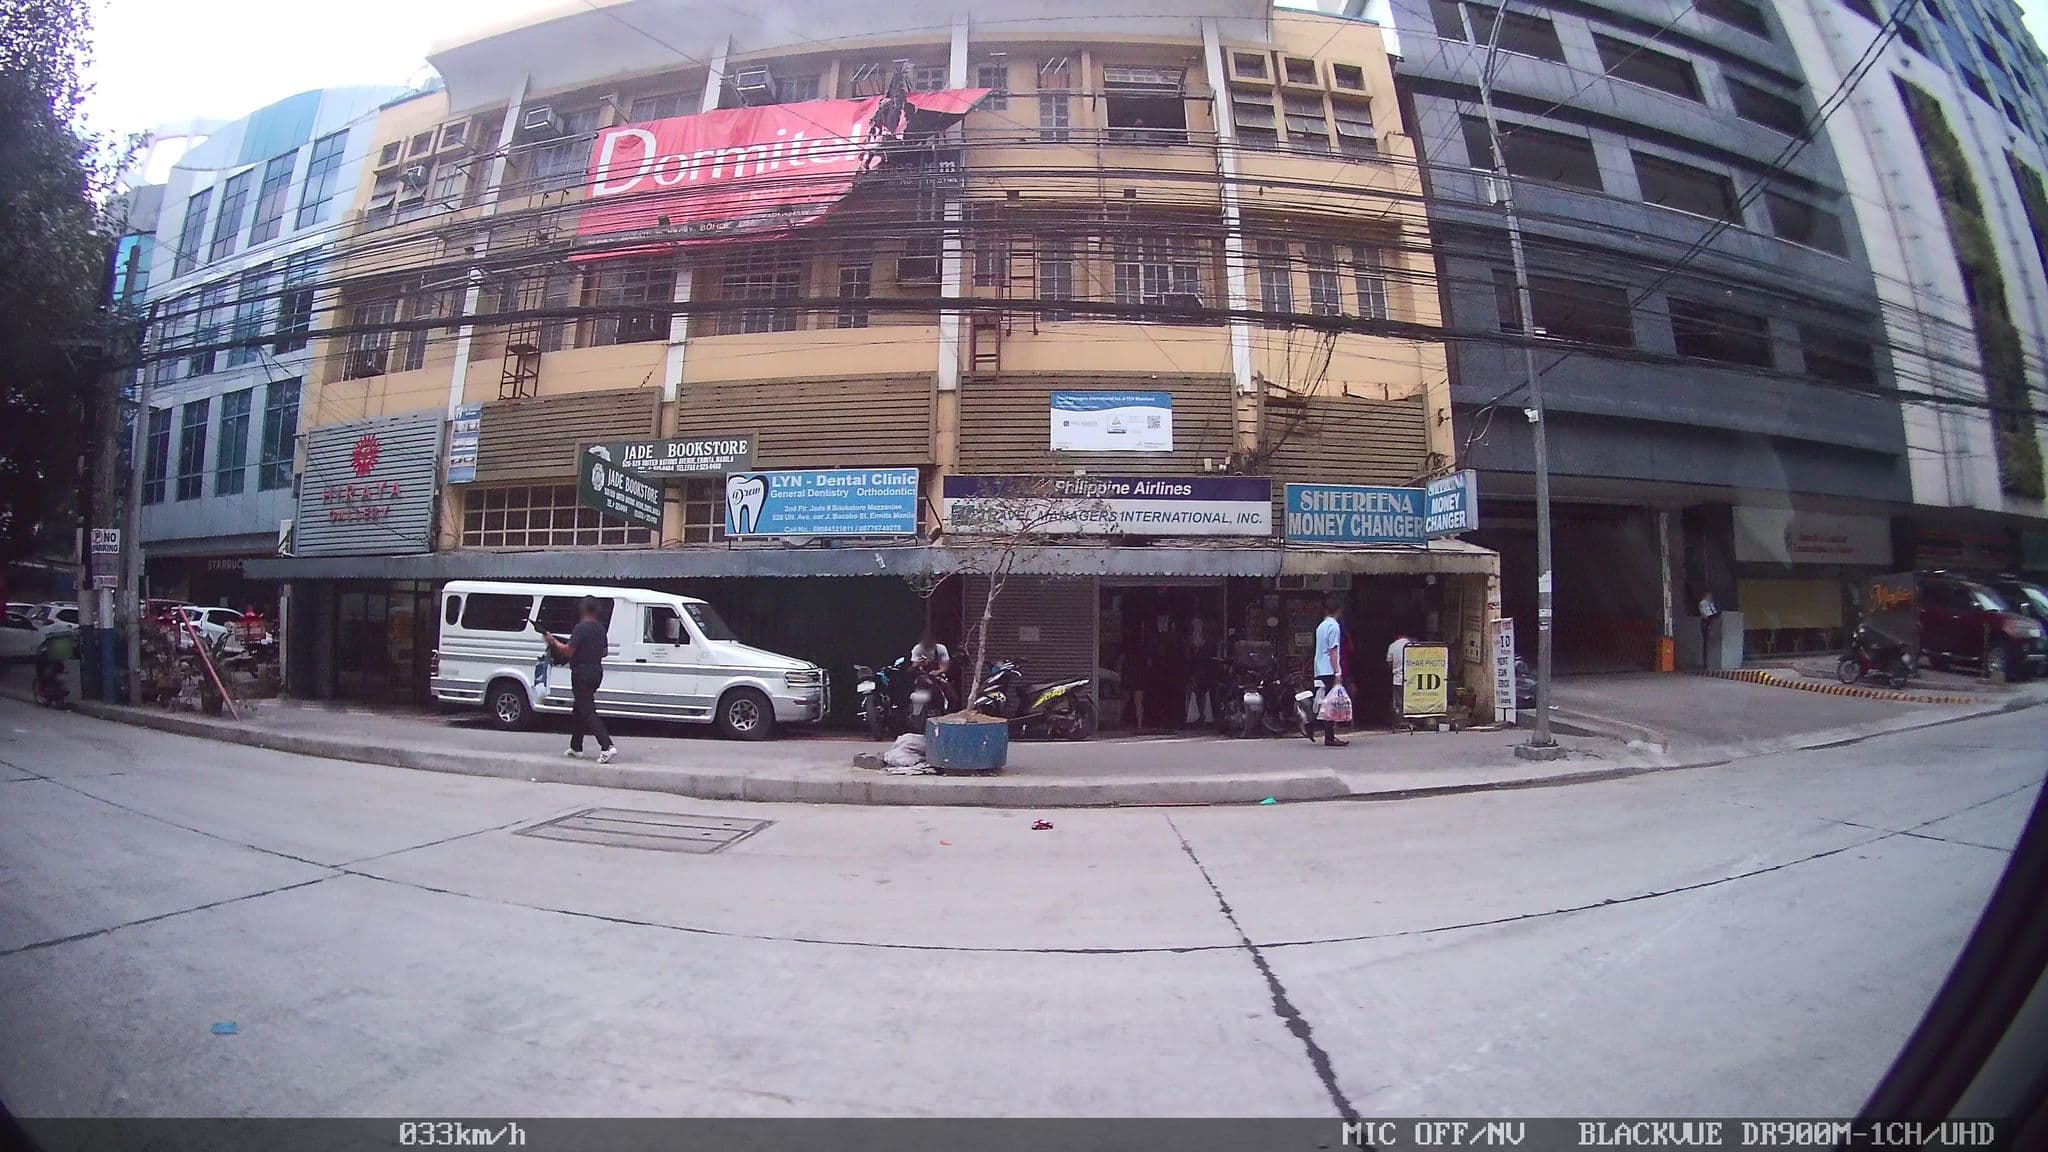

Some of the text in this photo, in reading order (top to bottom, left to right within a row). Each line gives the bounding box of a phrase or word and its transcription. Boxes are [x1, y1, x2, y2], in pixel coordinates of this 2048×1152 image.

[624, 440, 748, 460] JADE BOOKSTORE
[607, 468, 624, 489] JADE
[625, 476, 658, 504] BOOKSTORE
[771, 476, 802, 487] LYN
[816, 474, 867, 486] Dental
[871, 473, 916, 486] Clinic
[1055, 478, 1192, 497] Philippine Airlines
[770, 489, 806, 498] General
[807, 487, 848, 498] Dentistry
[1300, 490, 1413, 514] SHEEREENA
[1431, 493, 1461, 514] MONEY
[1037, 509, 1118, 522] MANAGERS
[1120, 511, 1232, 525] INTERNATIONAL,
[1236, 513, 1263, 524] INC.
[1288, 512, 1425, 538] MONEY CHANGER
[1425, 510, 1466, 533] CHANGER
[103, 533, 117, 543] NO
[92, 543, 118, 553] PARKING
[1500, 635, 1511, 648] ID
[1417, 674, 1441, 690] ID
